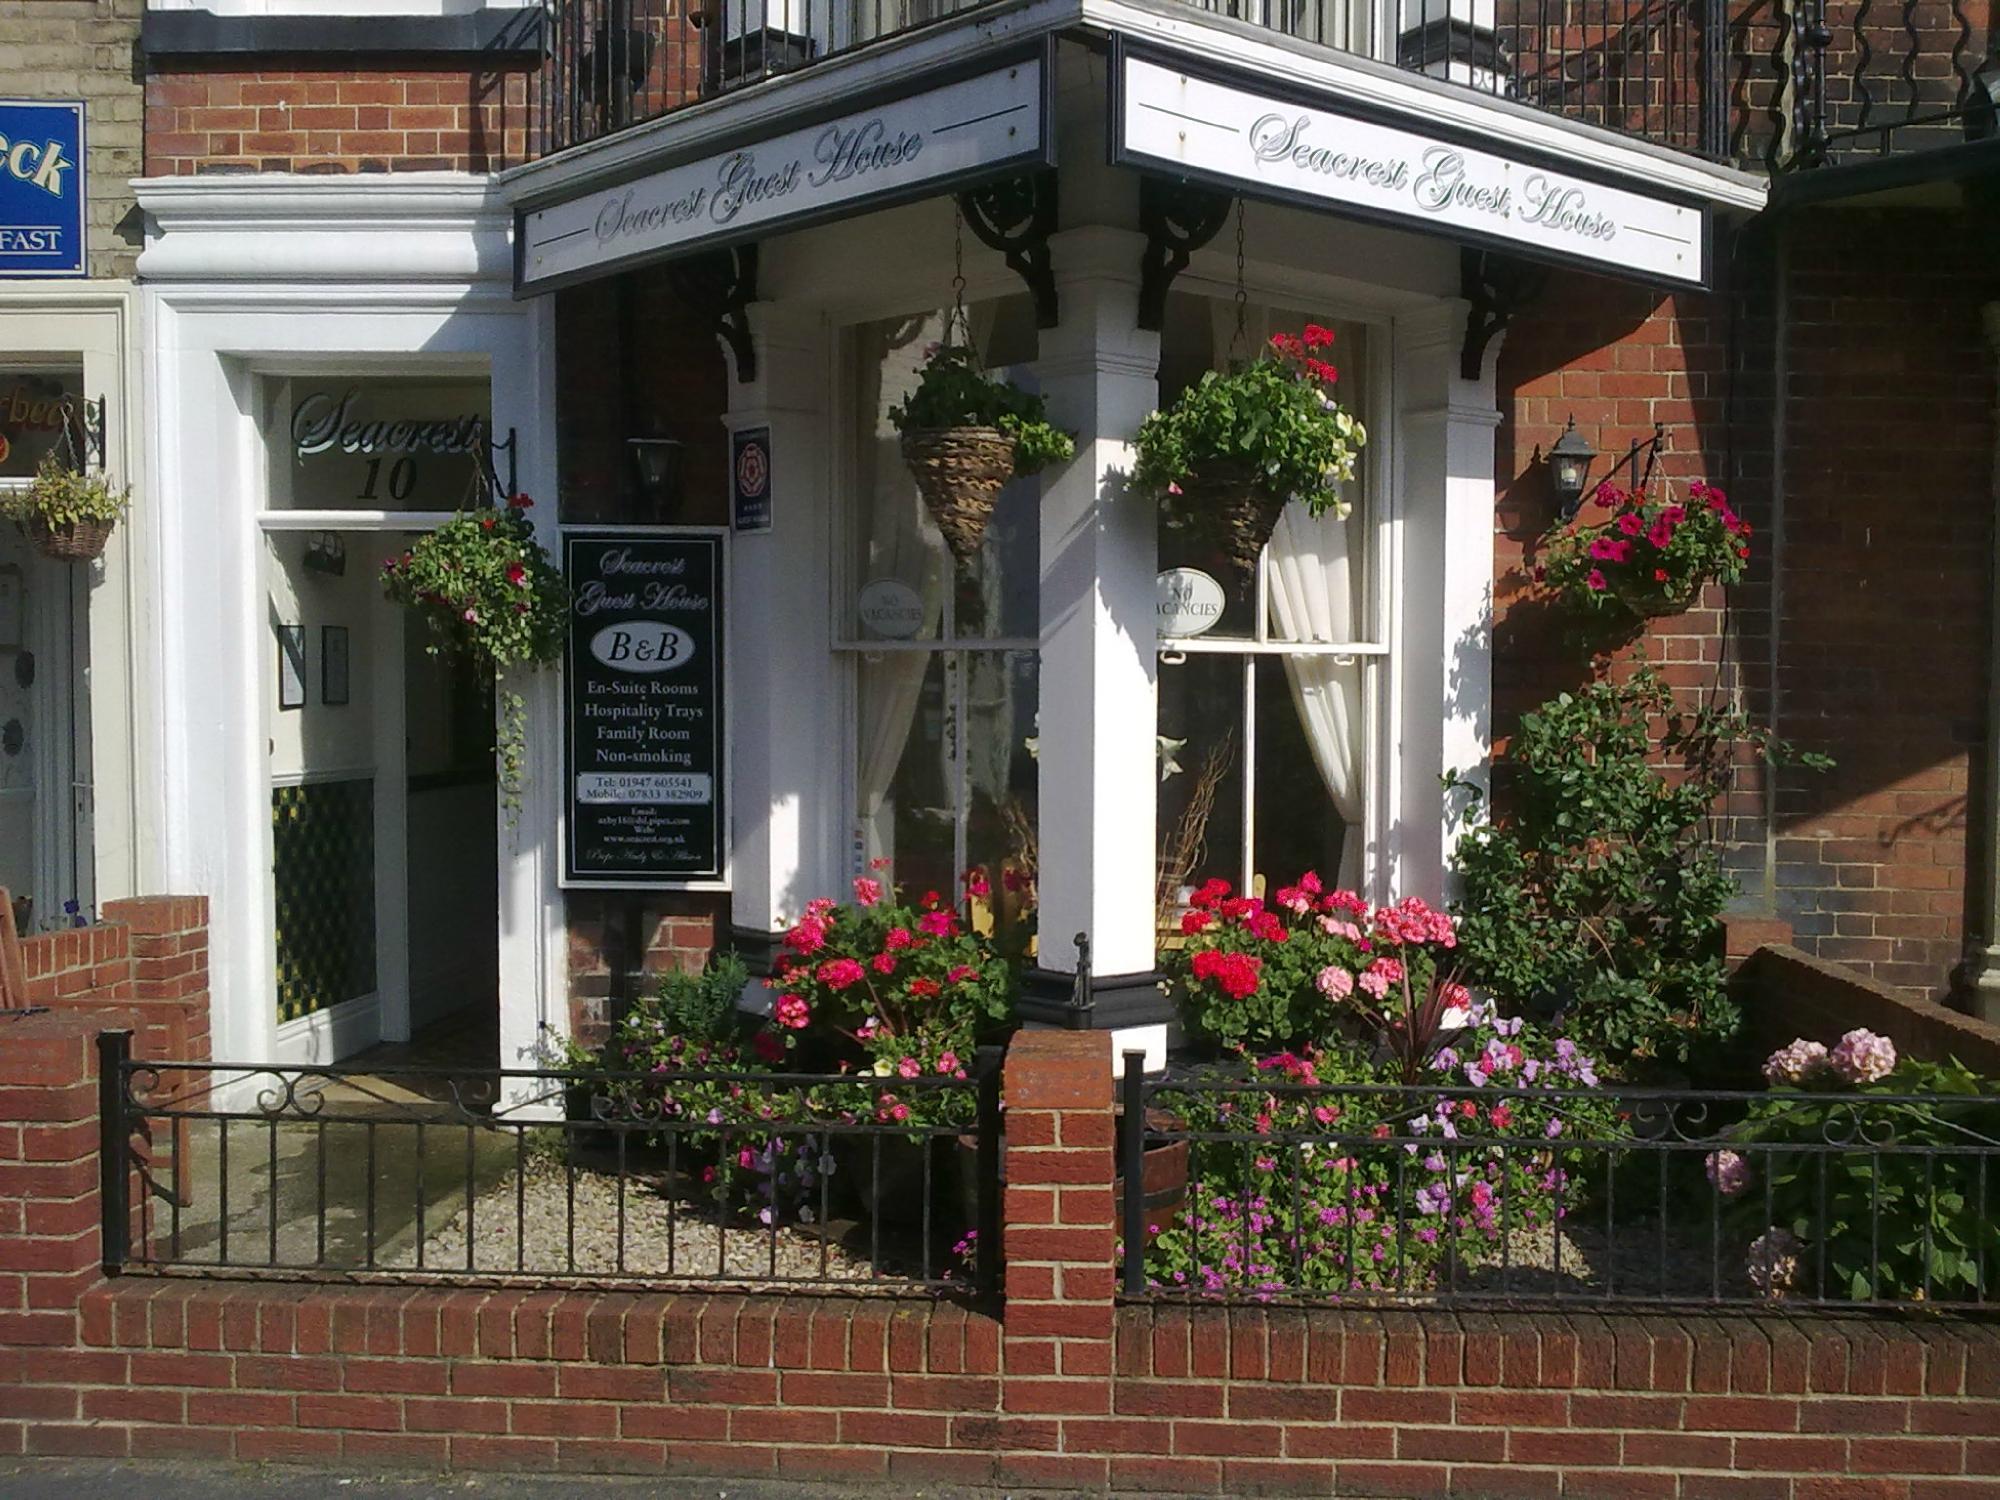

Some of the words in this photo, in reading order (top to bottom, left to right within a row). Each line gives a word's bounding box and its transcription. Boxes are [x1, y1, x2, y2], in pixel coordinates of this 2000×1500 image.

[595, 188, 704, 248] Seacrest
[709, 151, 800, 224] Guest
[808, 117, 922, 188] House
[1249, 112, 1409, 190] Seacrest
[1413, 145, 1512, 212] Guest
[1517, 173, 1616, 241] House
[291, 386, 482, 467] Seacrest
[357, 458, 417, 500] 10
[599, 548, 686, 575] Seacrest
[575, 580, 635, 616] Guest
[640, 581, 708, 610] House
[607, 631, 679, 661] B&B
[588, 680, 647, 694] En-Suite
[650, 681, 698, 694] Rooms
[584, 703, 661, 720] Hospitality
[664, 703, 703, 721] Trays
[597, 726, 645, 743] Family
[648, 727, 690, 740] Room
[596, 748, 692, 767] Non-smoking
[619, 777, 651, 788] 01947
